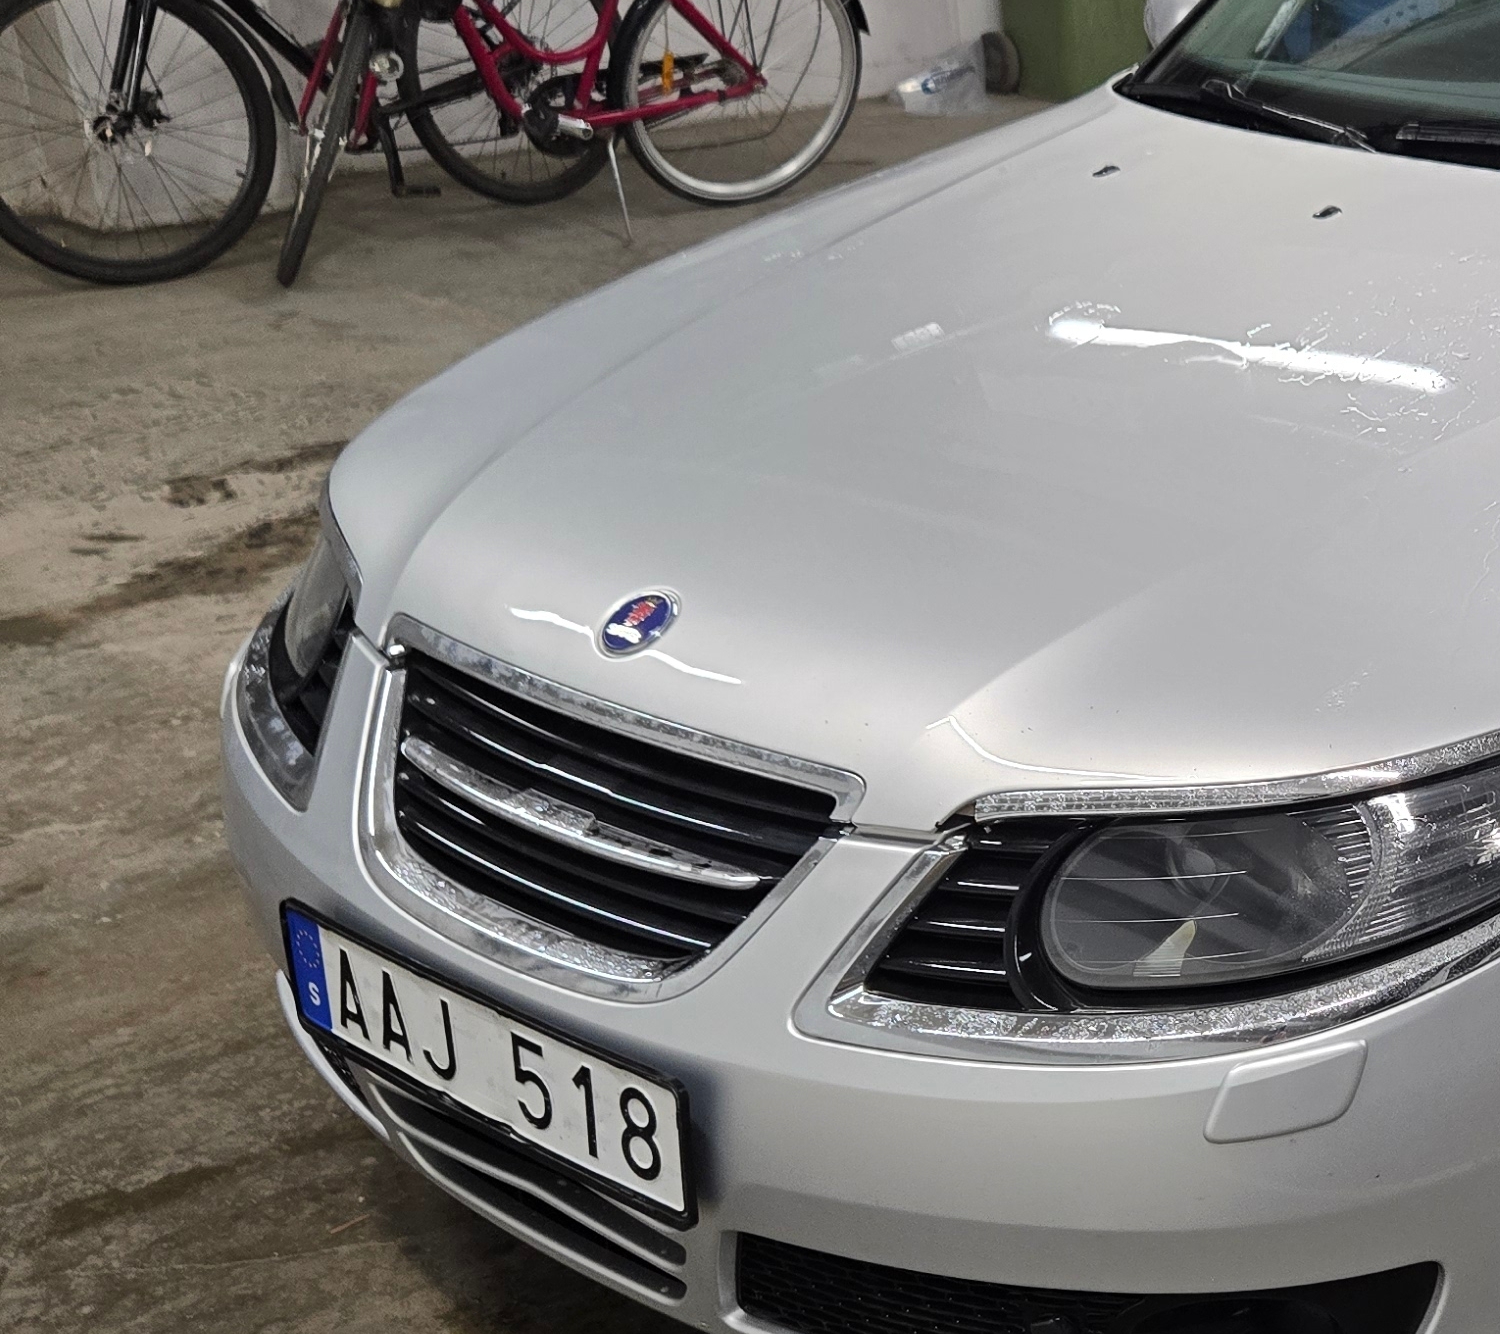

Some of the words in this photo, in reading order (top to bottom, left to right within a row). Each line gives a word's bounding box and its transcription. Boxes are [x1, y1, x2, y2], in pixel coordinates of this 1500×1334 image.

[309, 981, 320, 1007] S
[339, 948, 457, 1081] AAJ
[510, 1030, 662, 1181] 518
